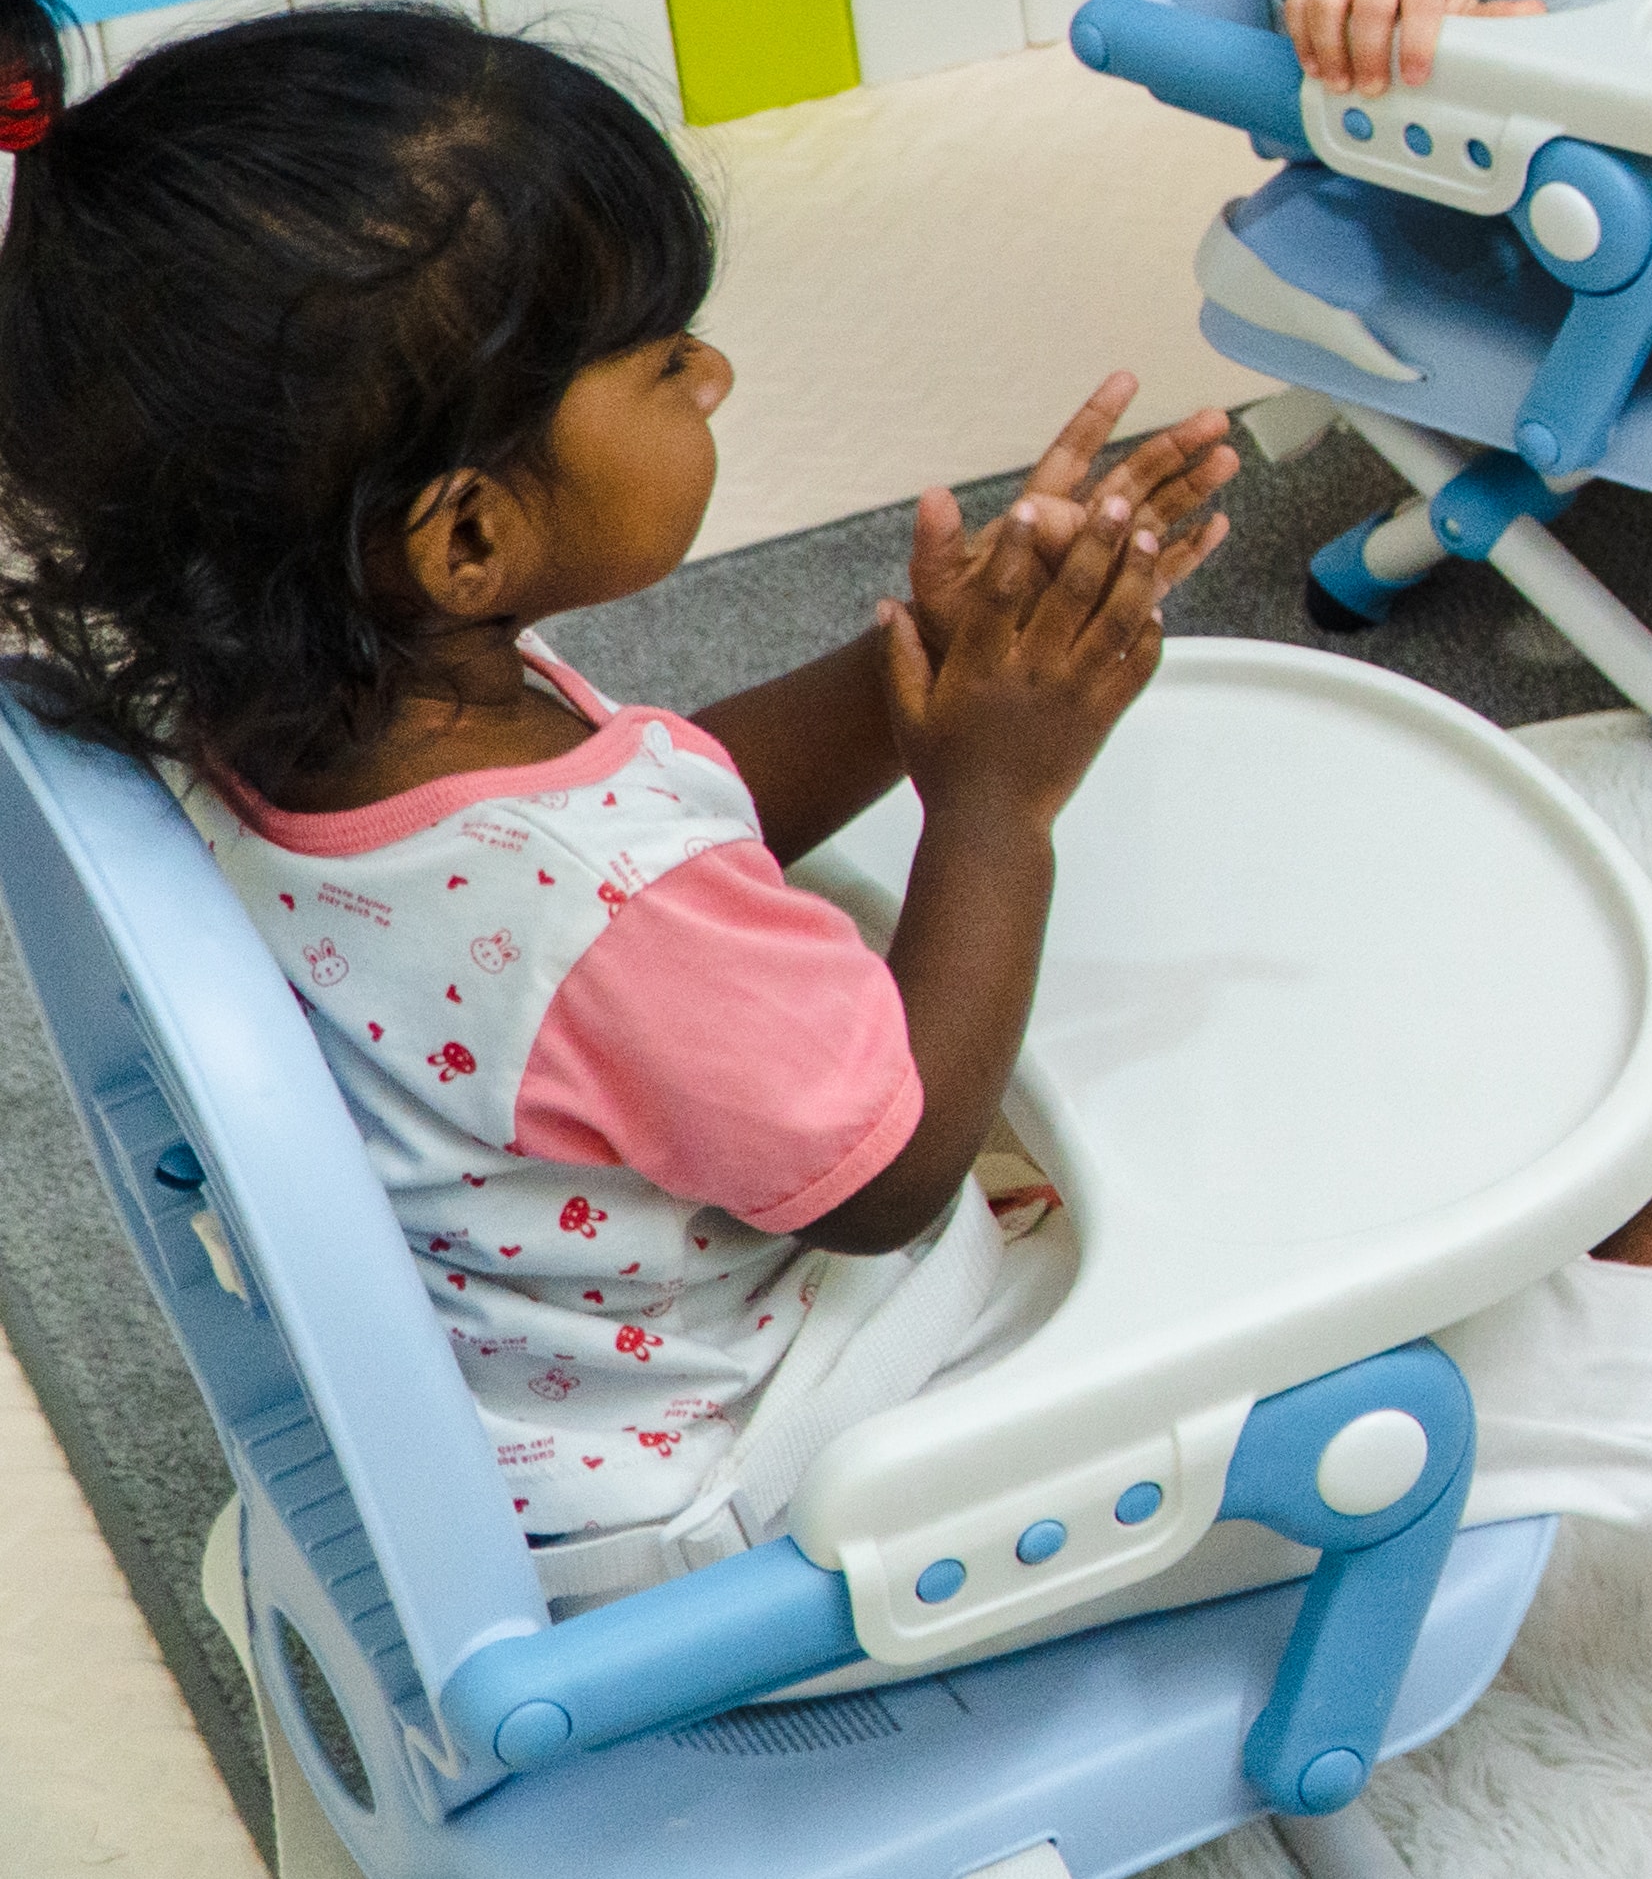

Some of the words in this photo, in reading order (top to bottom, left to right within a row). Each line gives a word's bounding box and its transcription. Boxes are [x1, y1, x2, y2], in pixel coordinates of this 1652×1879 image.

[317, 891, 340, 908] play
[343, 902, 370, 918] with
[357, 894, 392, 914] bunny
